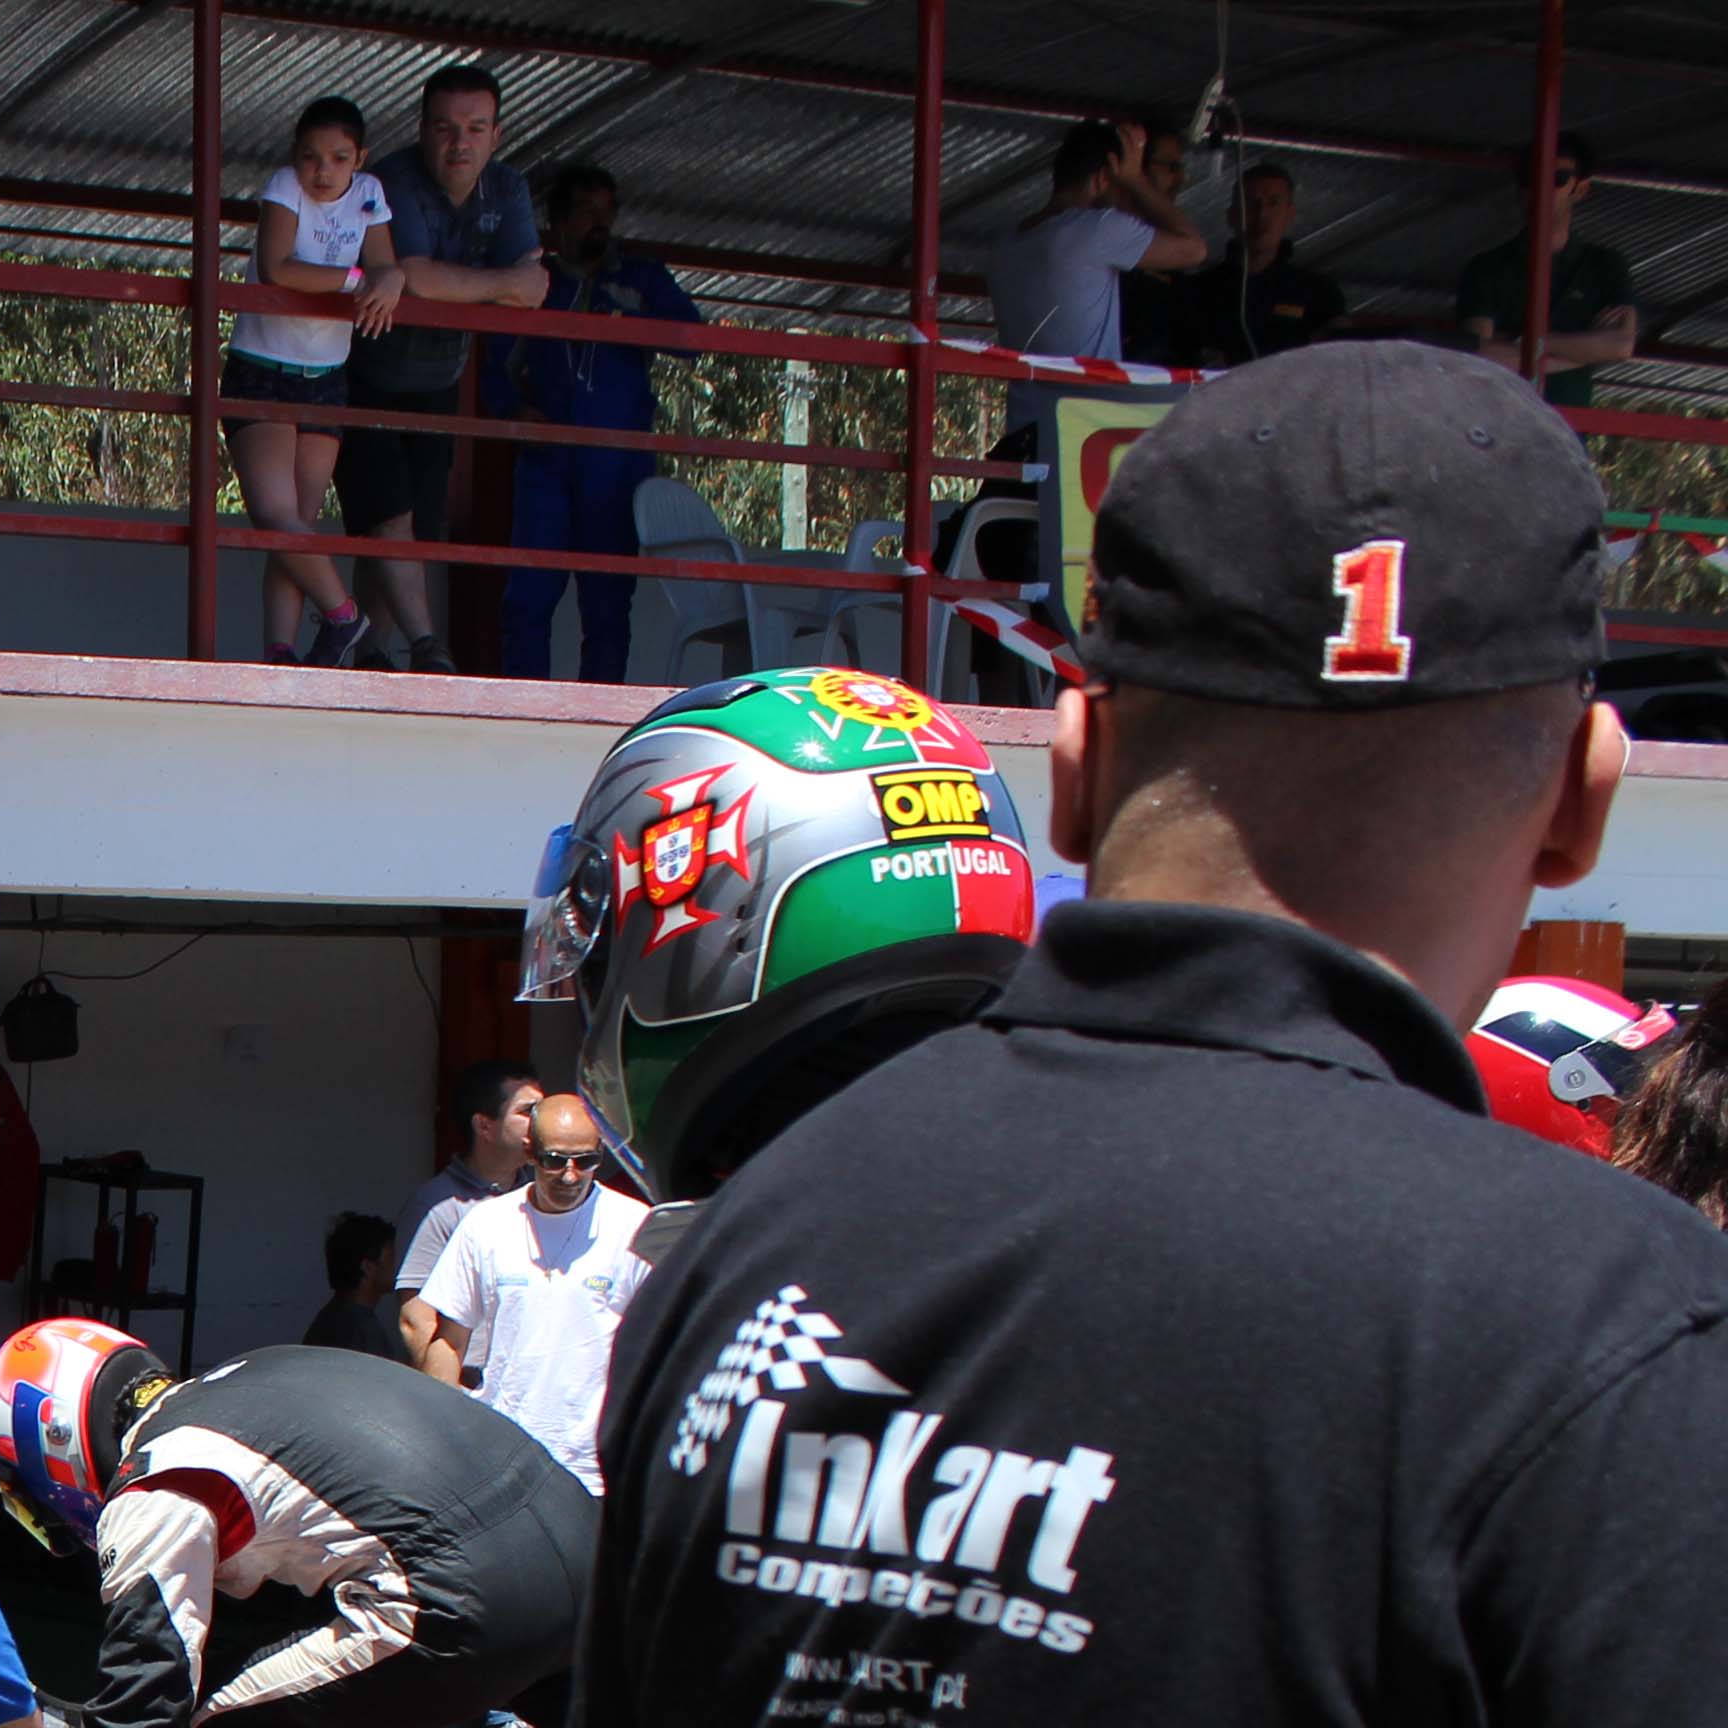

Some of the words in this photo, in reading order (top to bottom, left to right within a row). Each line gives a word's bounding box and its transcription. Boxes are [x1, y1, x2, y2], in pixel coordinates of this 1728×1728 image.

[1321, 539, 1413, 682] 1
[883, 780, 984, 828] OMP
[870, 845, 1012, 883] PORTUGAL
